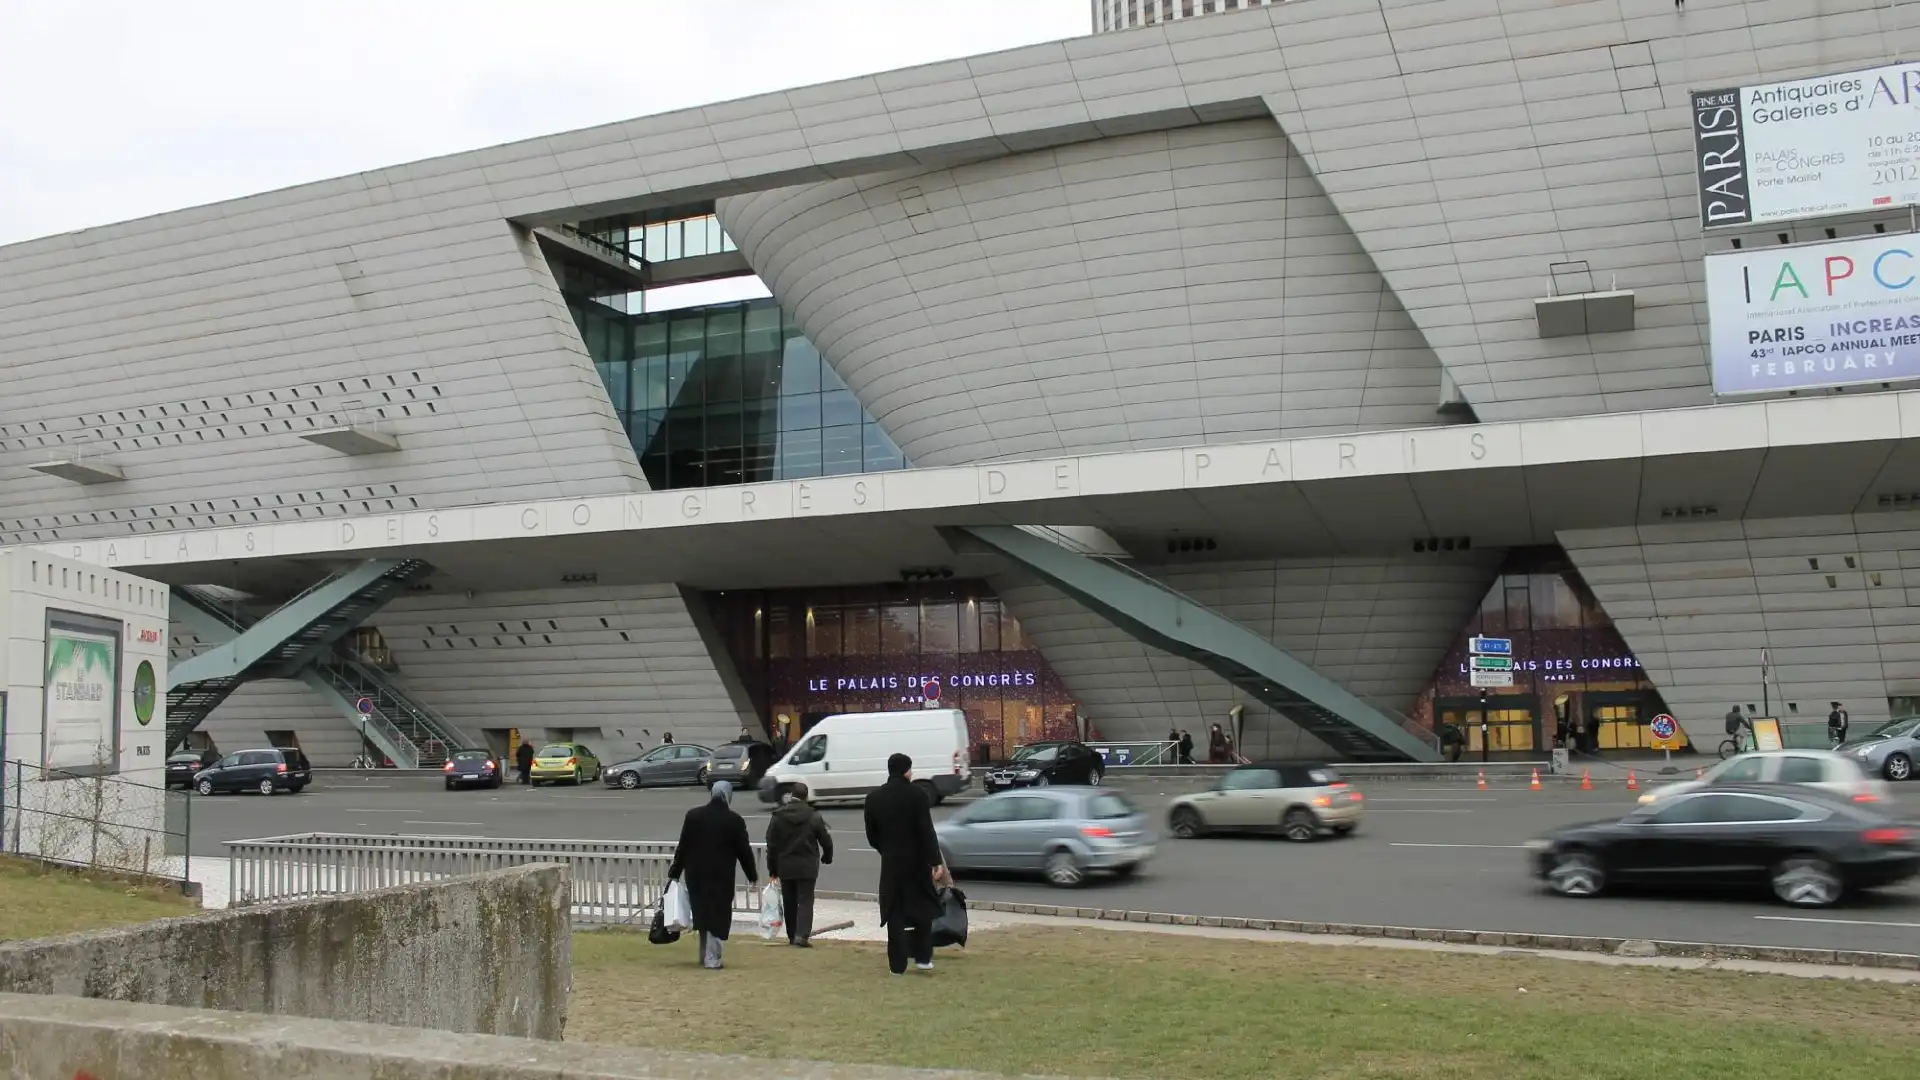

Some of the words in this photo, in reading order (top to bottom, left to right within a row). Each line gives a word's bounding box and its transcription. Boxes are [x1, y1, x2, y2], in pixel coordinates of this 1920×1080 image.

[1697, 96, 1716, 107] FINE
[1718, 93, 1735, 104] ART
[1751, 79, 1862, 106] Antiquaires
[1753, 101, 1838, 123] Galeries
[1868, 136, 1883, 147] 10
[1886, 135, 1903, 145] au
[1698, 107, 1746, 221] PARIS
[1755, 149, 1797, 163] PALAIS
[1757, 177, 1784, 187] Porte
[1787, 172, 1822, 184] Maillot
[1872, 164, 1919, 185] 2012
[1748, 326, 1805, 344] PARIS
[1830, 314, 1920, 337] INCREAS
[1782, 343, 1826, 356] IAPCO
[1831, 338, 1887, 352] ANNUAL
[1751, 351, 1896, 378] FEBRUARY
[73, 531, 256, 562] PALAIS
[342, 515, 440, 543] DES
[987, 465, 1069, 496] DE
[1195, 432, 1487, 479] PARIS
[1545, 659, 1573, 669] DES
[809, 679, 828, 691] LE
[837, 677, 898, 690] PALAIS
[908, 676, 940, 688] DES
[950, 669, 1035, 688] CONGRÈS
[901, 696, 923, 704] PAR
[1119, 754, 1127, 764] P
